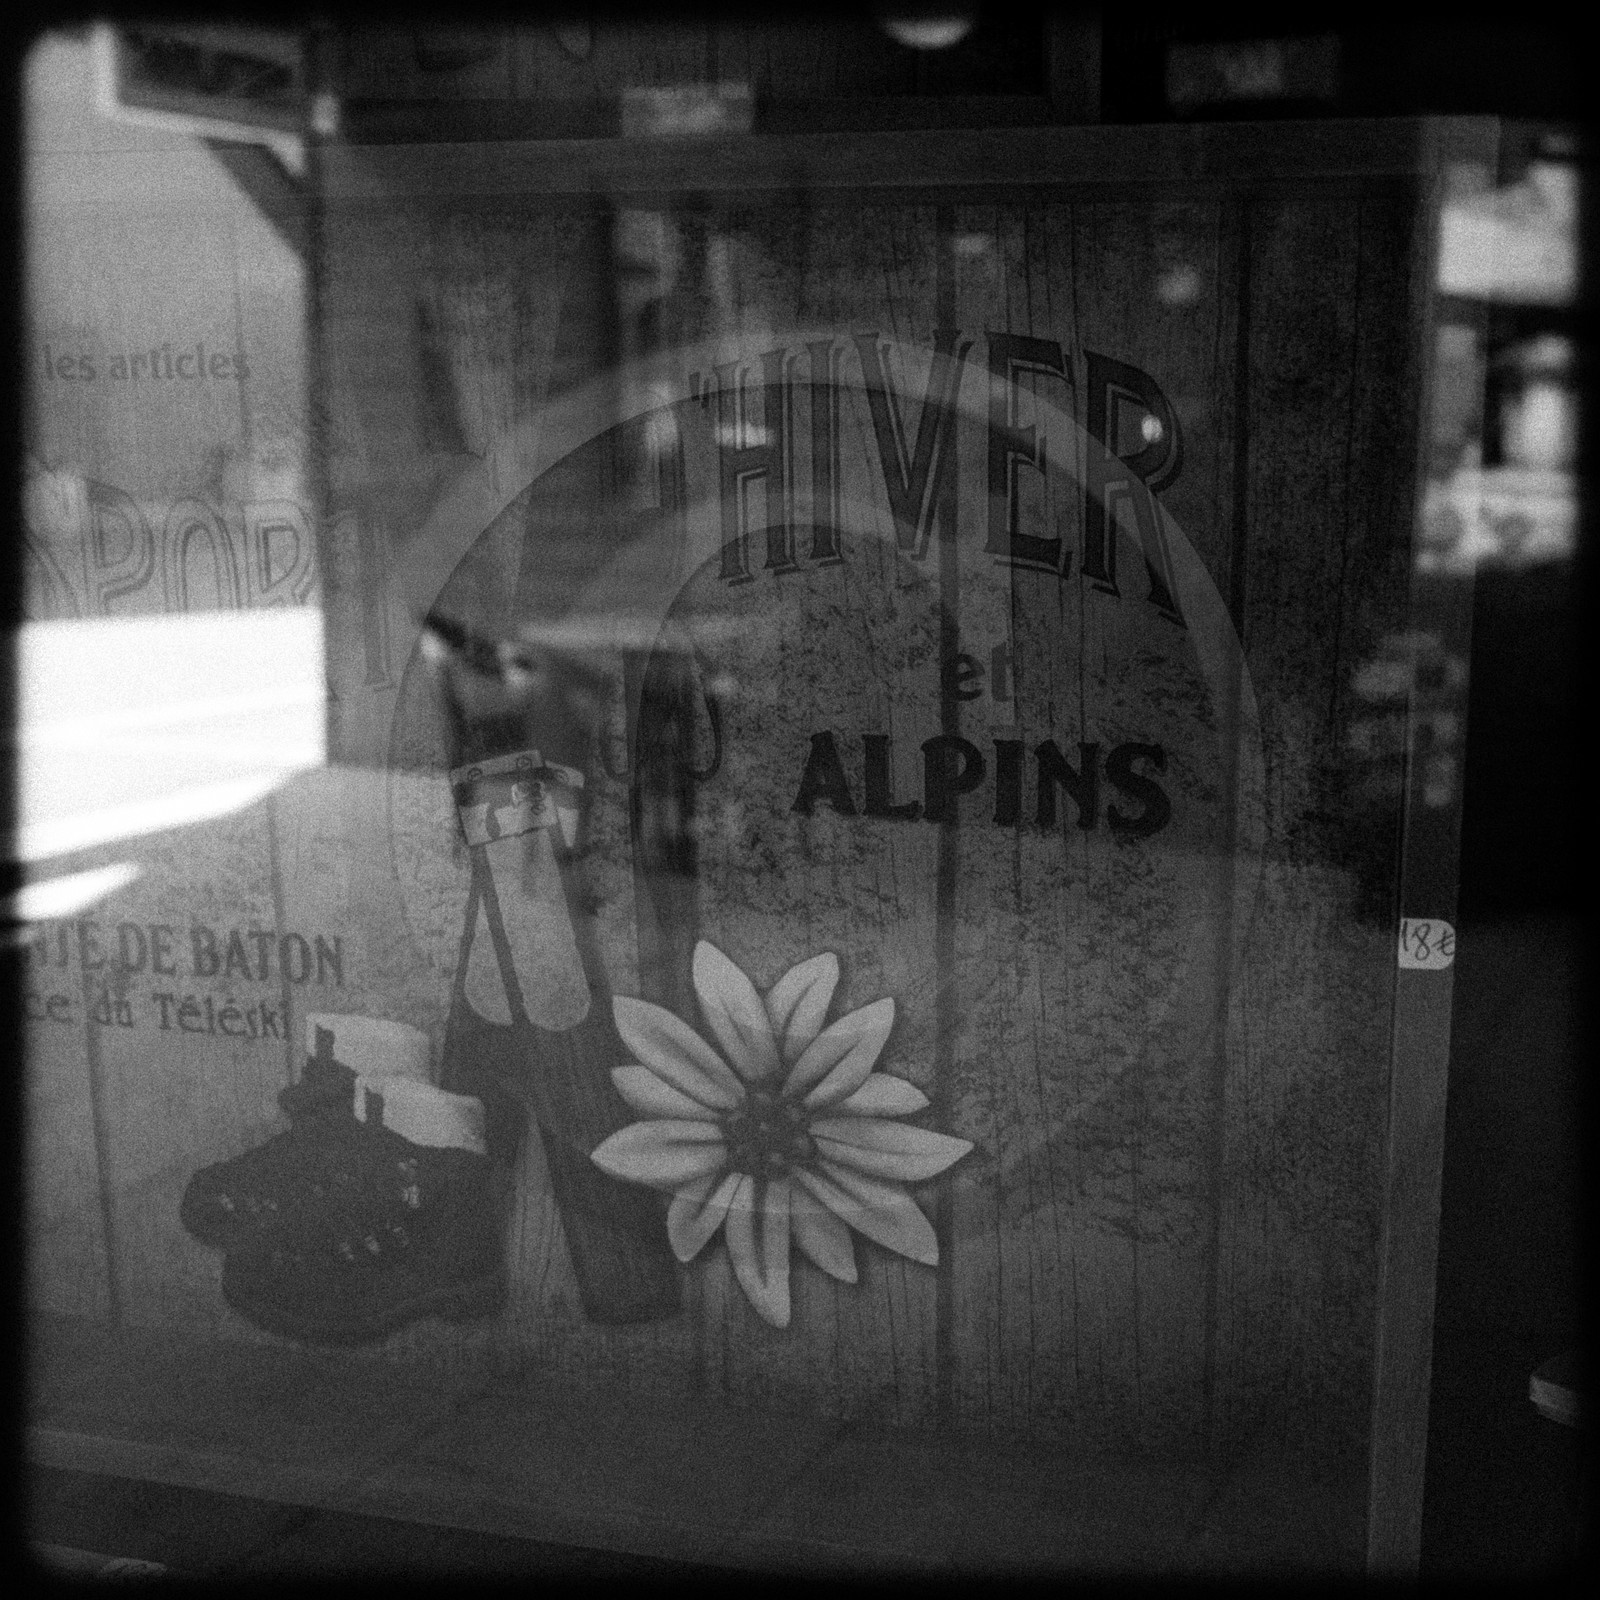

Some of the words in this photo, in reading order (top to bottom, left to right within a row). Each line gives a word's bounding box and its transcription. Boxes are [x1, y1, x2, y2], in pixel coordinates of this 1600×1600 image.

[44, 343, 98, 382] les
[109, 342, 252, 382] articles
[791, 730, 1173, 838] ALPINS
[117, 922, 176, 976] DE
[190, 924, 345, 988] BATON
[92, 984, 135, 1029] du
